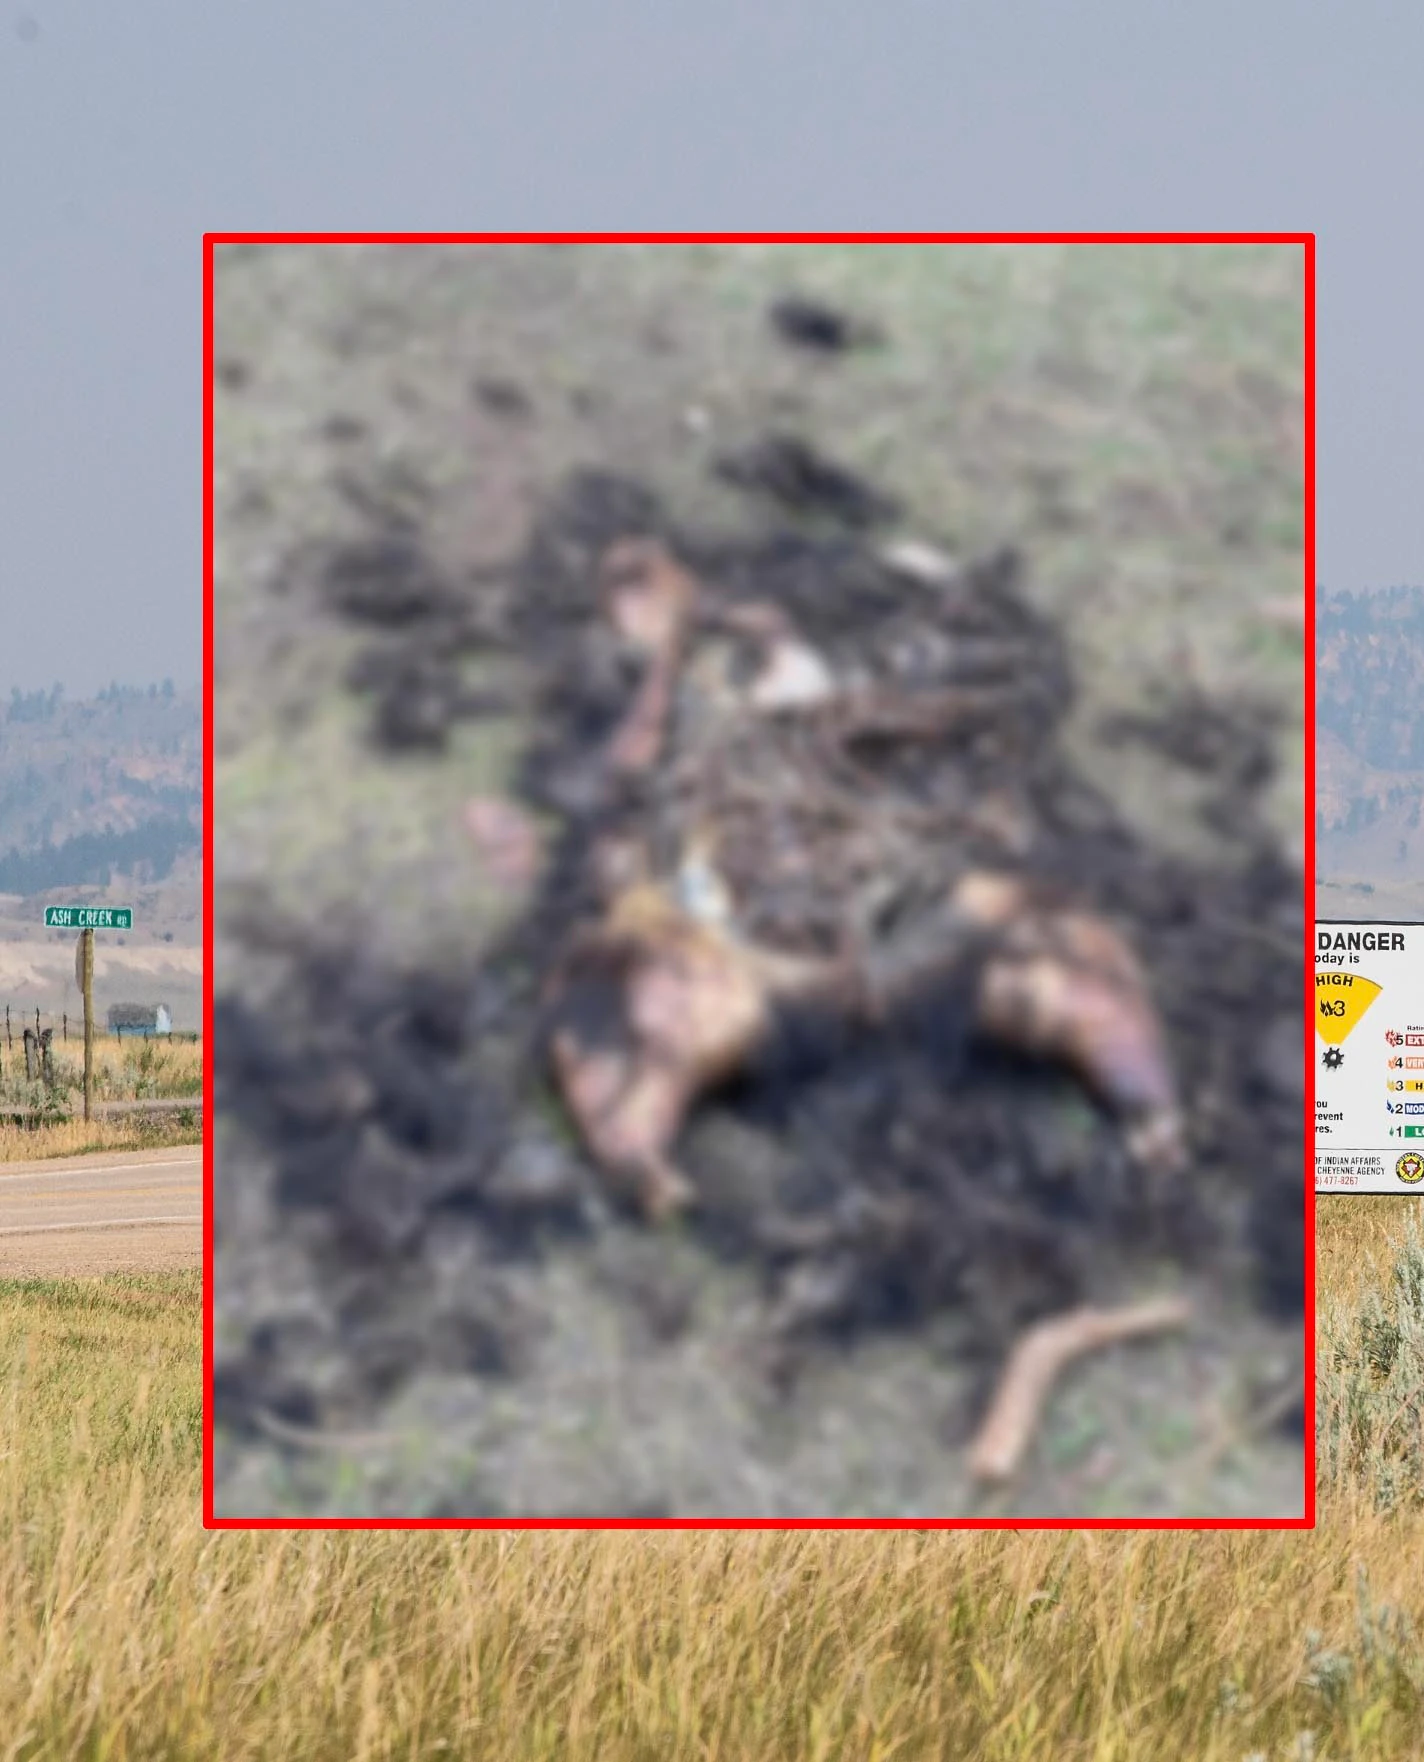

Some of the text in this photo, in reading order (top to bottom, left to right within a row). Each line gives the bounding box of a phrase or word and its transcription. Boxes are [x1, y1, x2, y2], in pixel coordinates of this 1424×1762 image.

[50, 909, 72, 925] ASH
[78, 910, 112, 925] CREEK
[1318, 932, 1405, 951] DANGER
[1315, 953, 1360, 966] oday is
[1316, 974, 1353, 987] HIGH
[1333, 1000, 1346, 1017] 3
[1396, 1035, 1404, 1045] 5
[1395, 1057, 1403, 1068] 4
[1395, 1080, 1404, 1091] 3
[1395, 1104, 1404, 1114] 2
[1315, 1112, 1343, 1120] revent
[1315, 1125, 1333, 1133] res.
[1396, 1127, 1402, 1137] 1
[1325, 1157, 1349, 1165] INDIAN
[1351, 1157, 1381, 1165] AFFAIRS
[1317, 1166, 1385, 1175] CHEYENNE AGENCY
